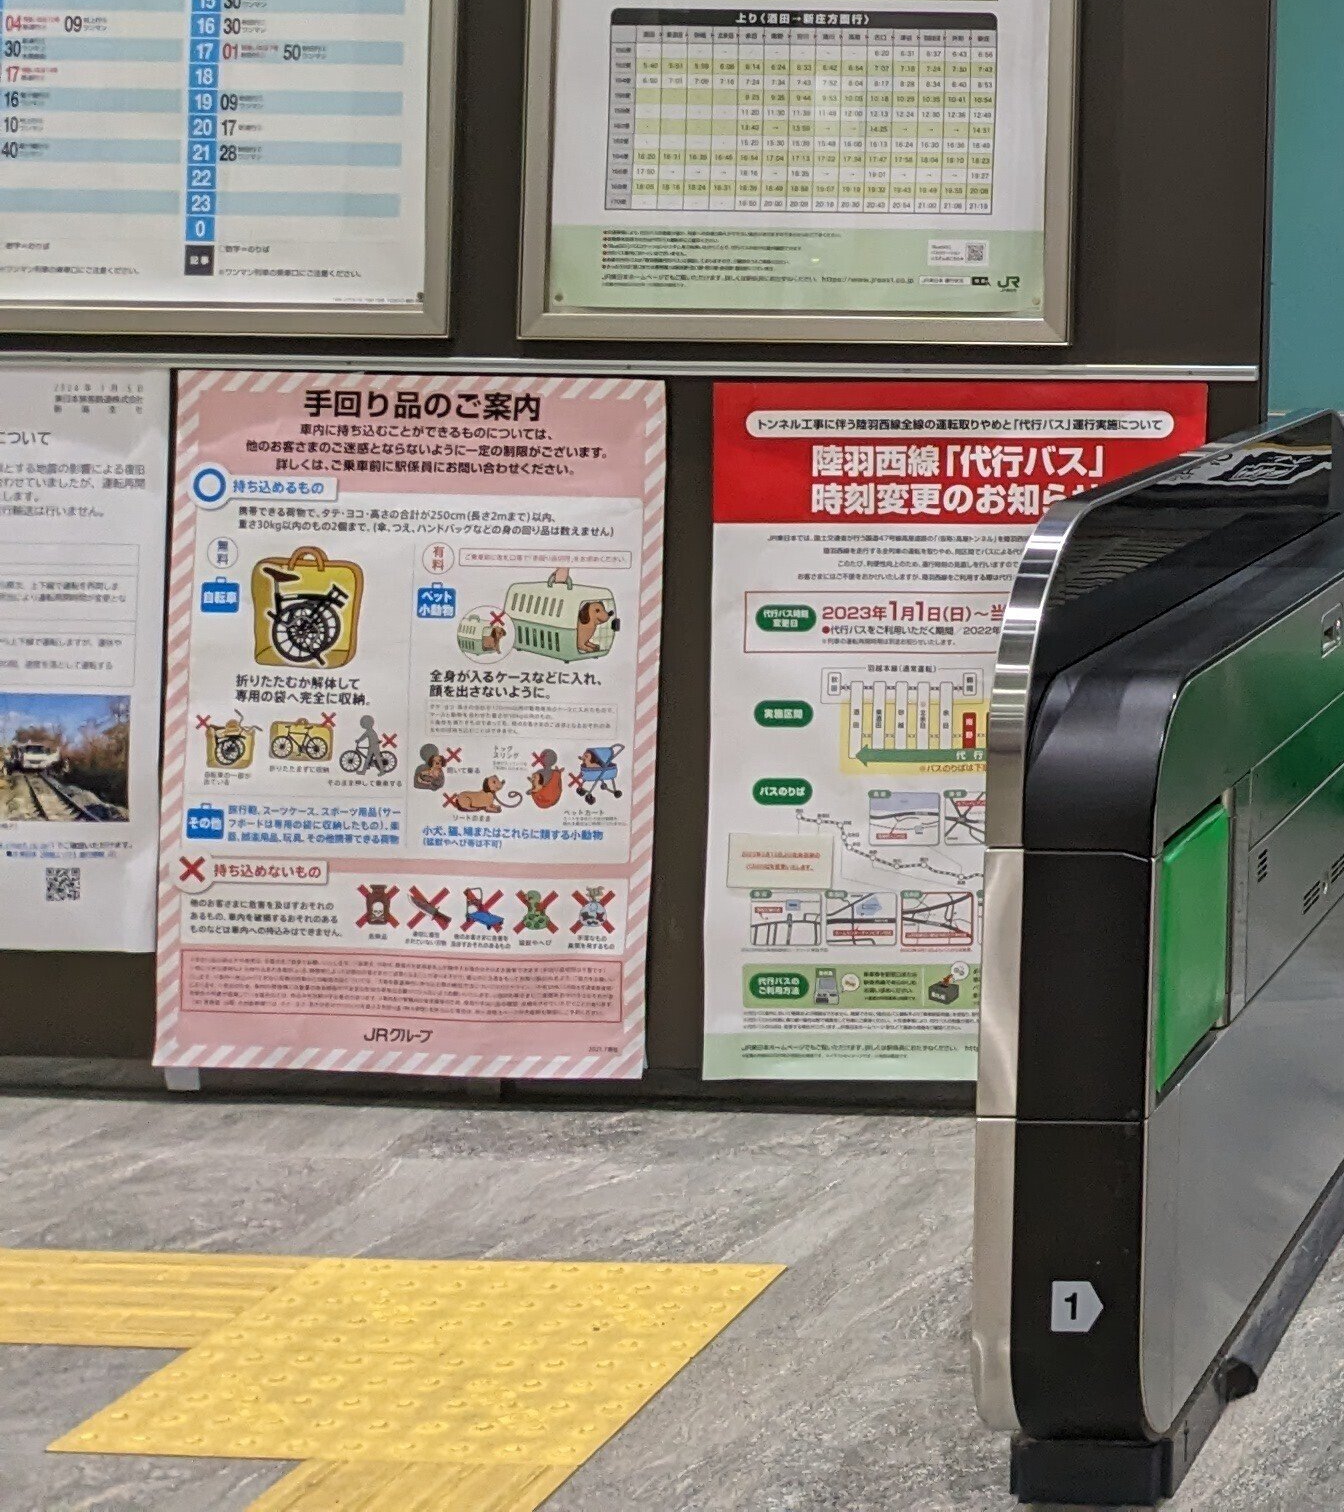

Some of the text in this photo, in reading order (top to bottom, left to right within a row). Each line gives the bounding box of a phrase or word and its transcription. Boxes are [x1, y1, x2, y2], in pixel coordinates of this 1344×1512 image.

[192, 194, 210, 211] 23
[304, 391, 541, 421] 手回り品のご案内
[812, 444, 1104, 478] 陸羽西線「代行バス」
[233, 480, 324, 495] 持ち込めるもの
[214, 864, 321, 878] 持ち込めないもの
[364, 1028, 433, 1044] JRグループ
[1065, 1292, 1077, 1320] 1
